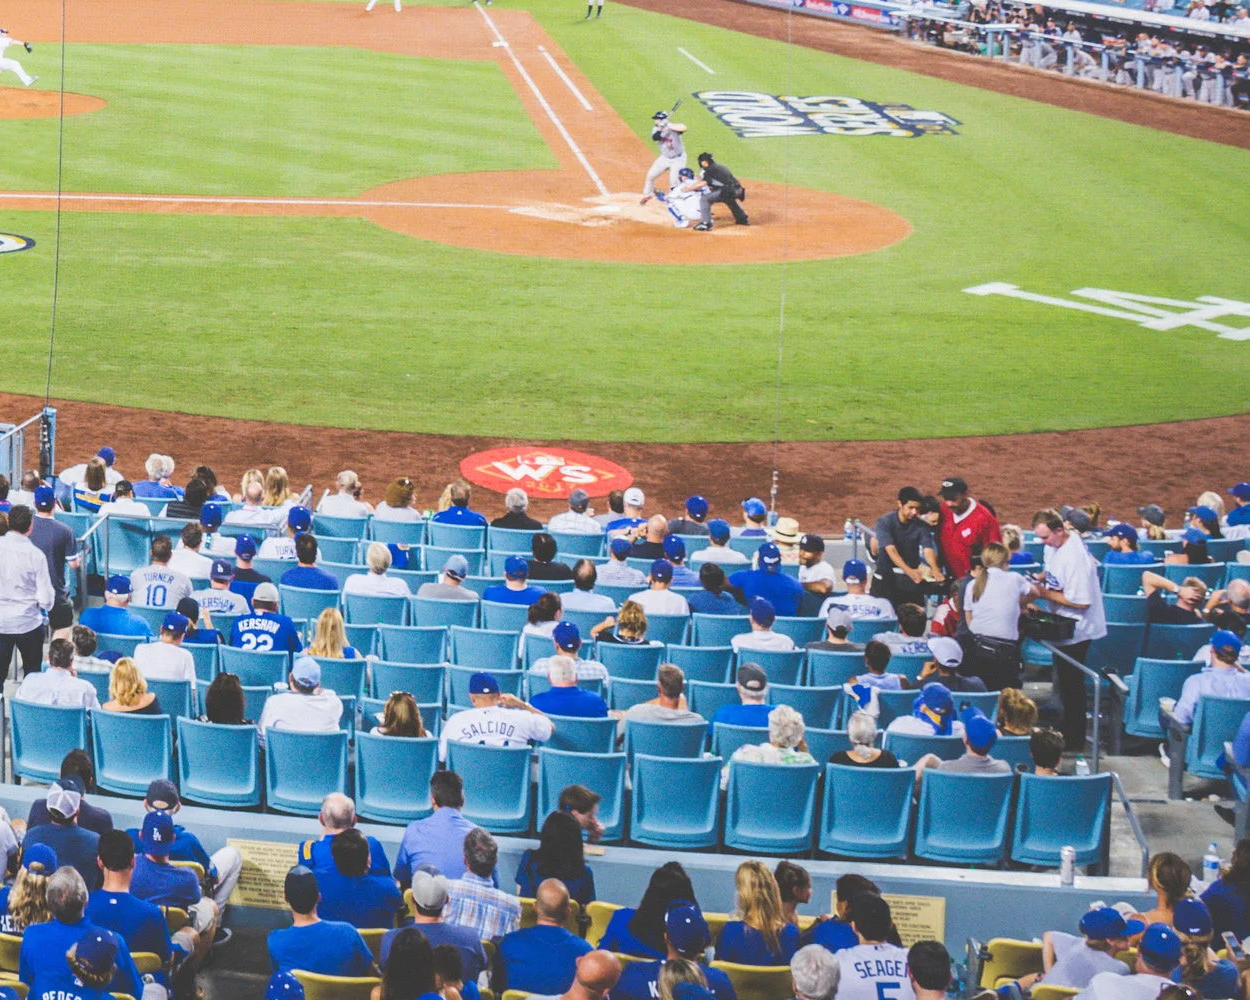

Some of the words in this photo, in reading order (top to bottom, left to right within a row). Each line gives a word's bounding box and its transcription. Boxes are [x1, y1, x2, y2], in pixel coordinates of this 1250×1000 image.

[491, 460, 597, 484] WS
[144, 571, 175, 585] TURNER
[146, 584, 167, 607] 10
[198, 595, 235, 611] ERSHA
[238, 618, 280, 634] KERSHAW
[241, 633, 274, 651] 22
[461, 720, 515, 739] SALCIDO
[876, 982, 901, 1000] 5
